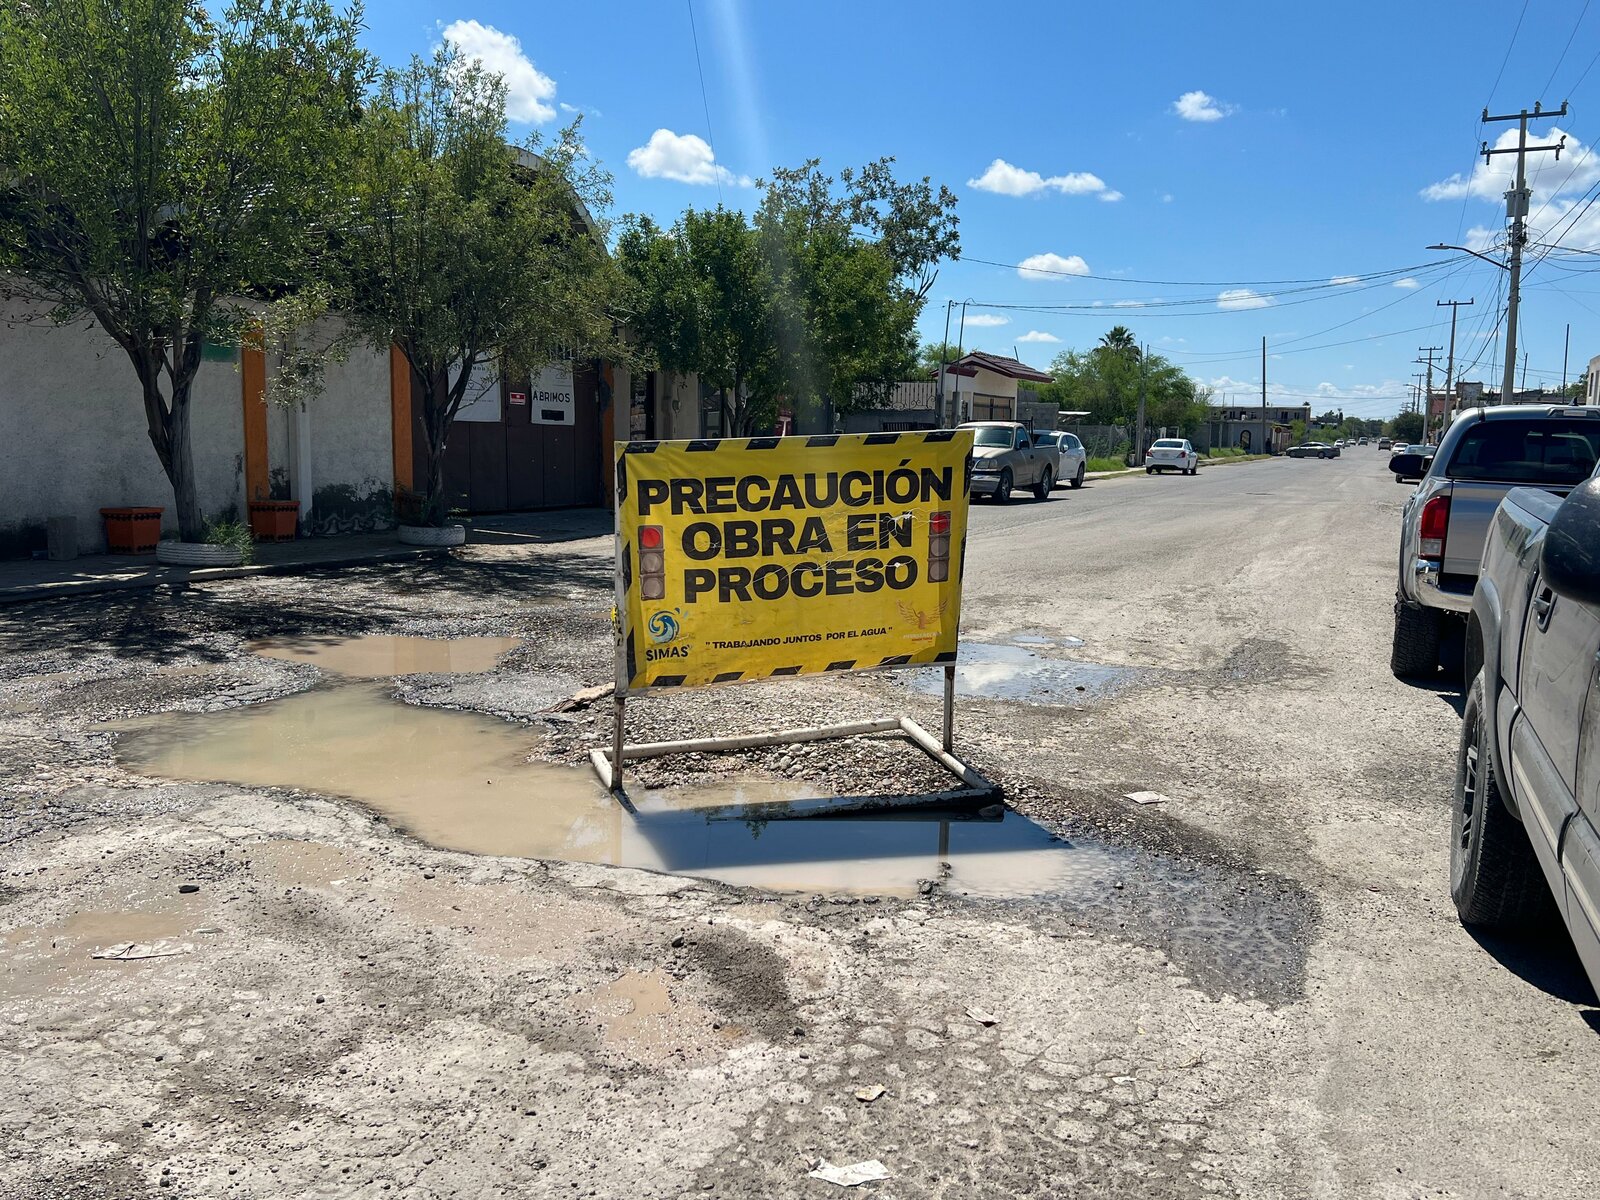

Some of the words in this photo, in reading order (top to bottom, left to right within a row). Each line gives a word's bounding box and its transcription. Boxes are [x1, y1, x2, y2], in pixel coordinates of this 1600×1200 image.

[533, 390, 571, 403] ABRIMOS
[637, 458, 953, 516] PRECAUCIÓN
[681, 516, 833, 561] OBRA
[847, 511, 913, 552] EN
[683, 555, 918, 604] PROCESO
[782, 633, 822, 645] JUNTOS
[826, 631, 846, 641] POR
[847, 630, 859, 638] EL
[861, 627, 887, 637] AGUA
[645, 646, 689, 661] SIMAS
